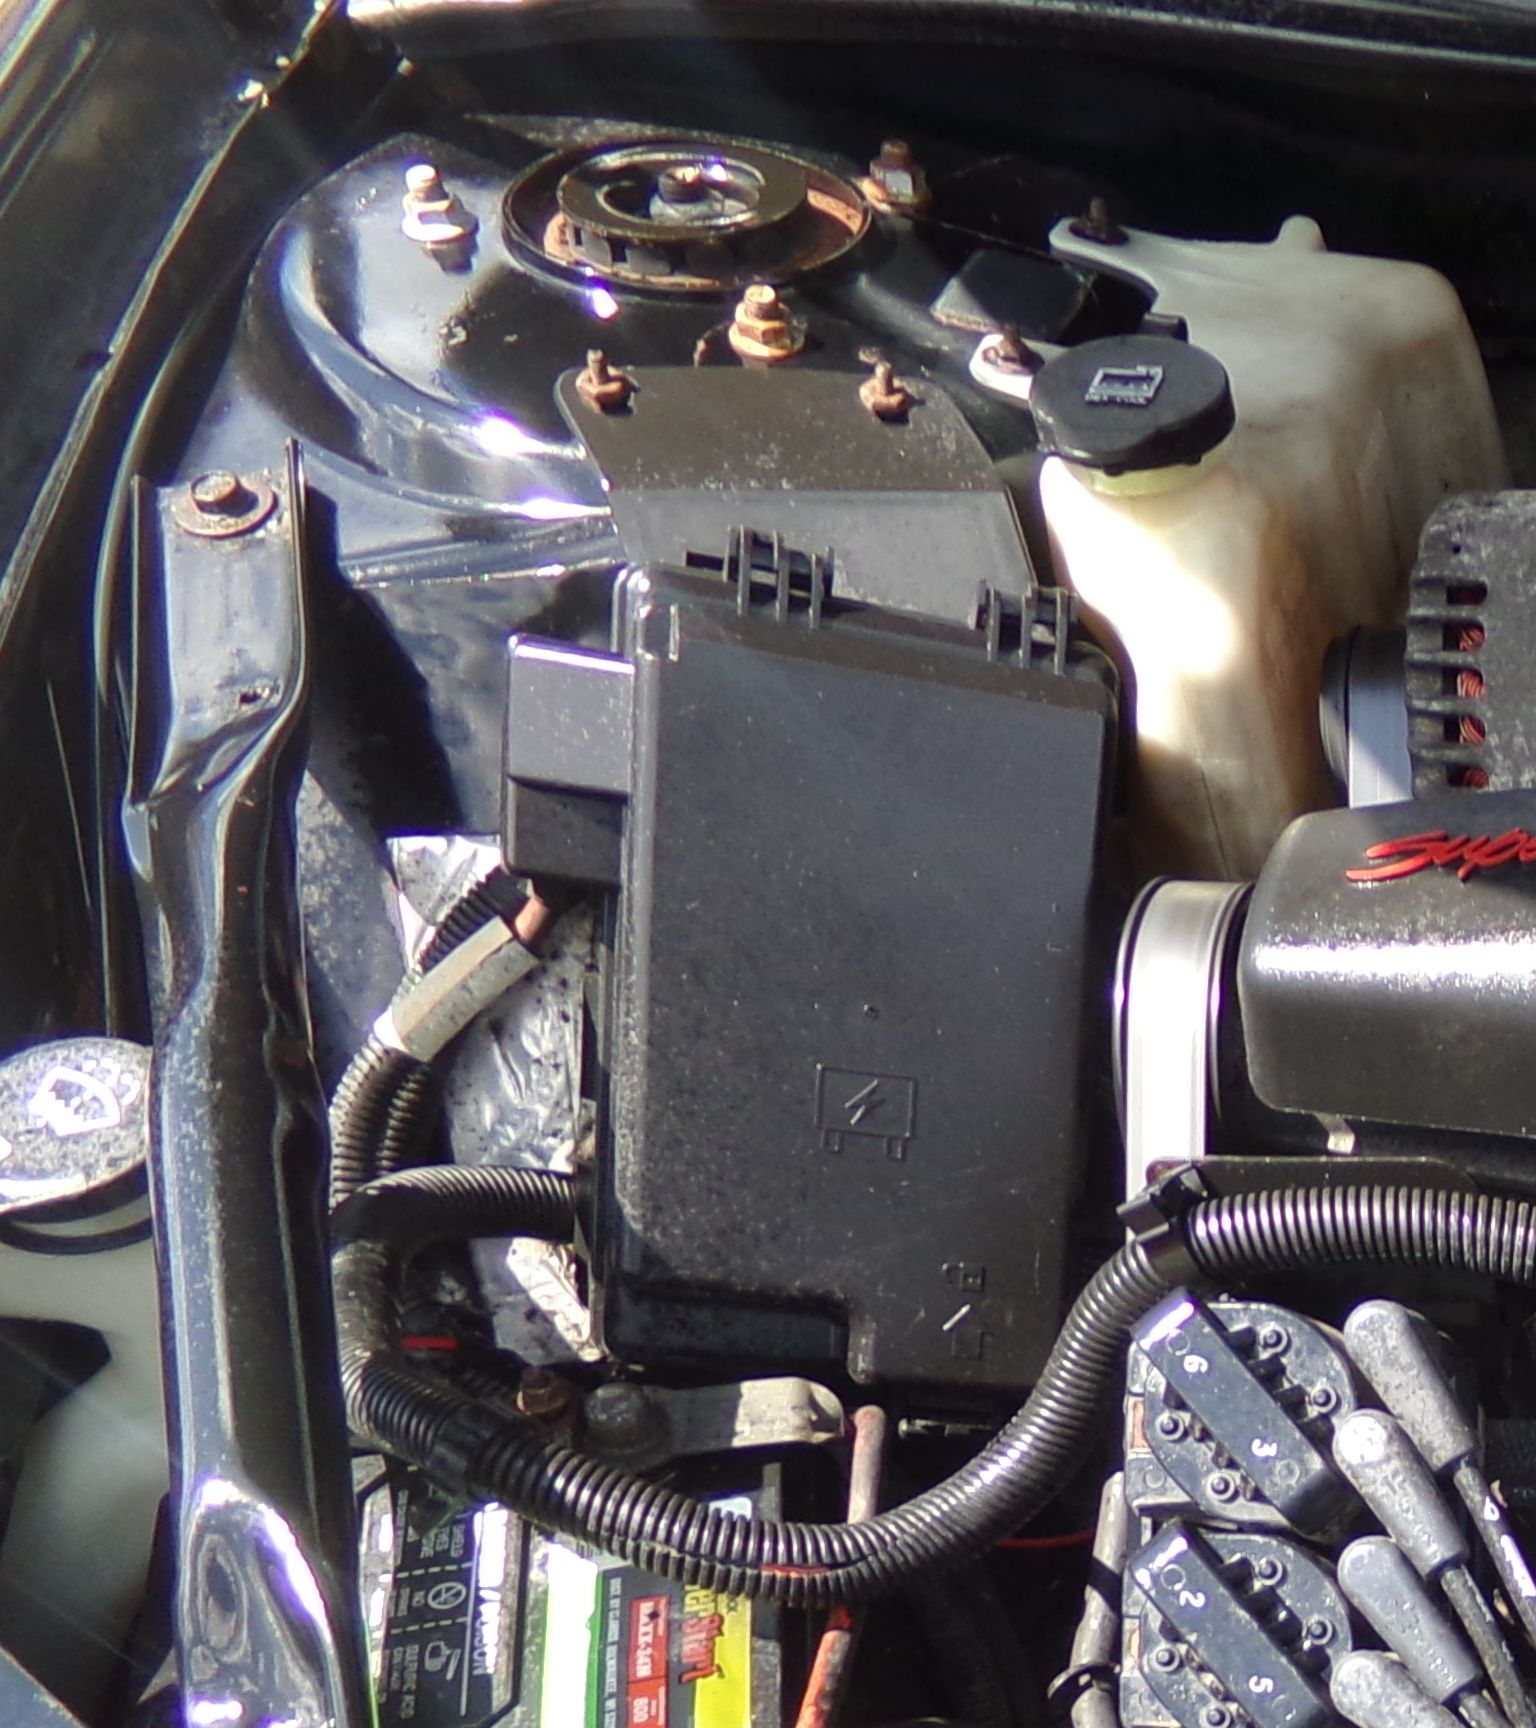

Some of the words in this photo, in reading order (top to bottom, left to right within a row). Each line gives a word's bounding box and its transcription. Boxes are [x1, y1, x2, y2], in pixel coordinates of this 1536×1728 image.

[1182, 1354, 1209, 1374] 6
[1252, 1438, 1278, 1457] 3
[1179, 1590, 1206, 1609] 2
[1248, 1675, 1274, 1694] 5
